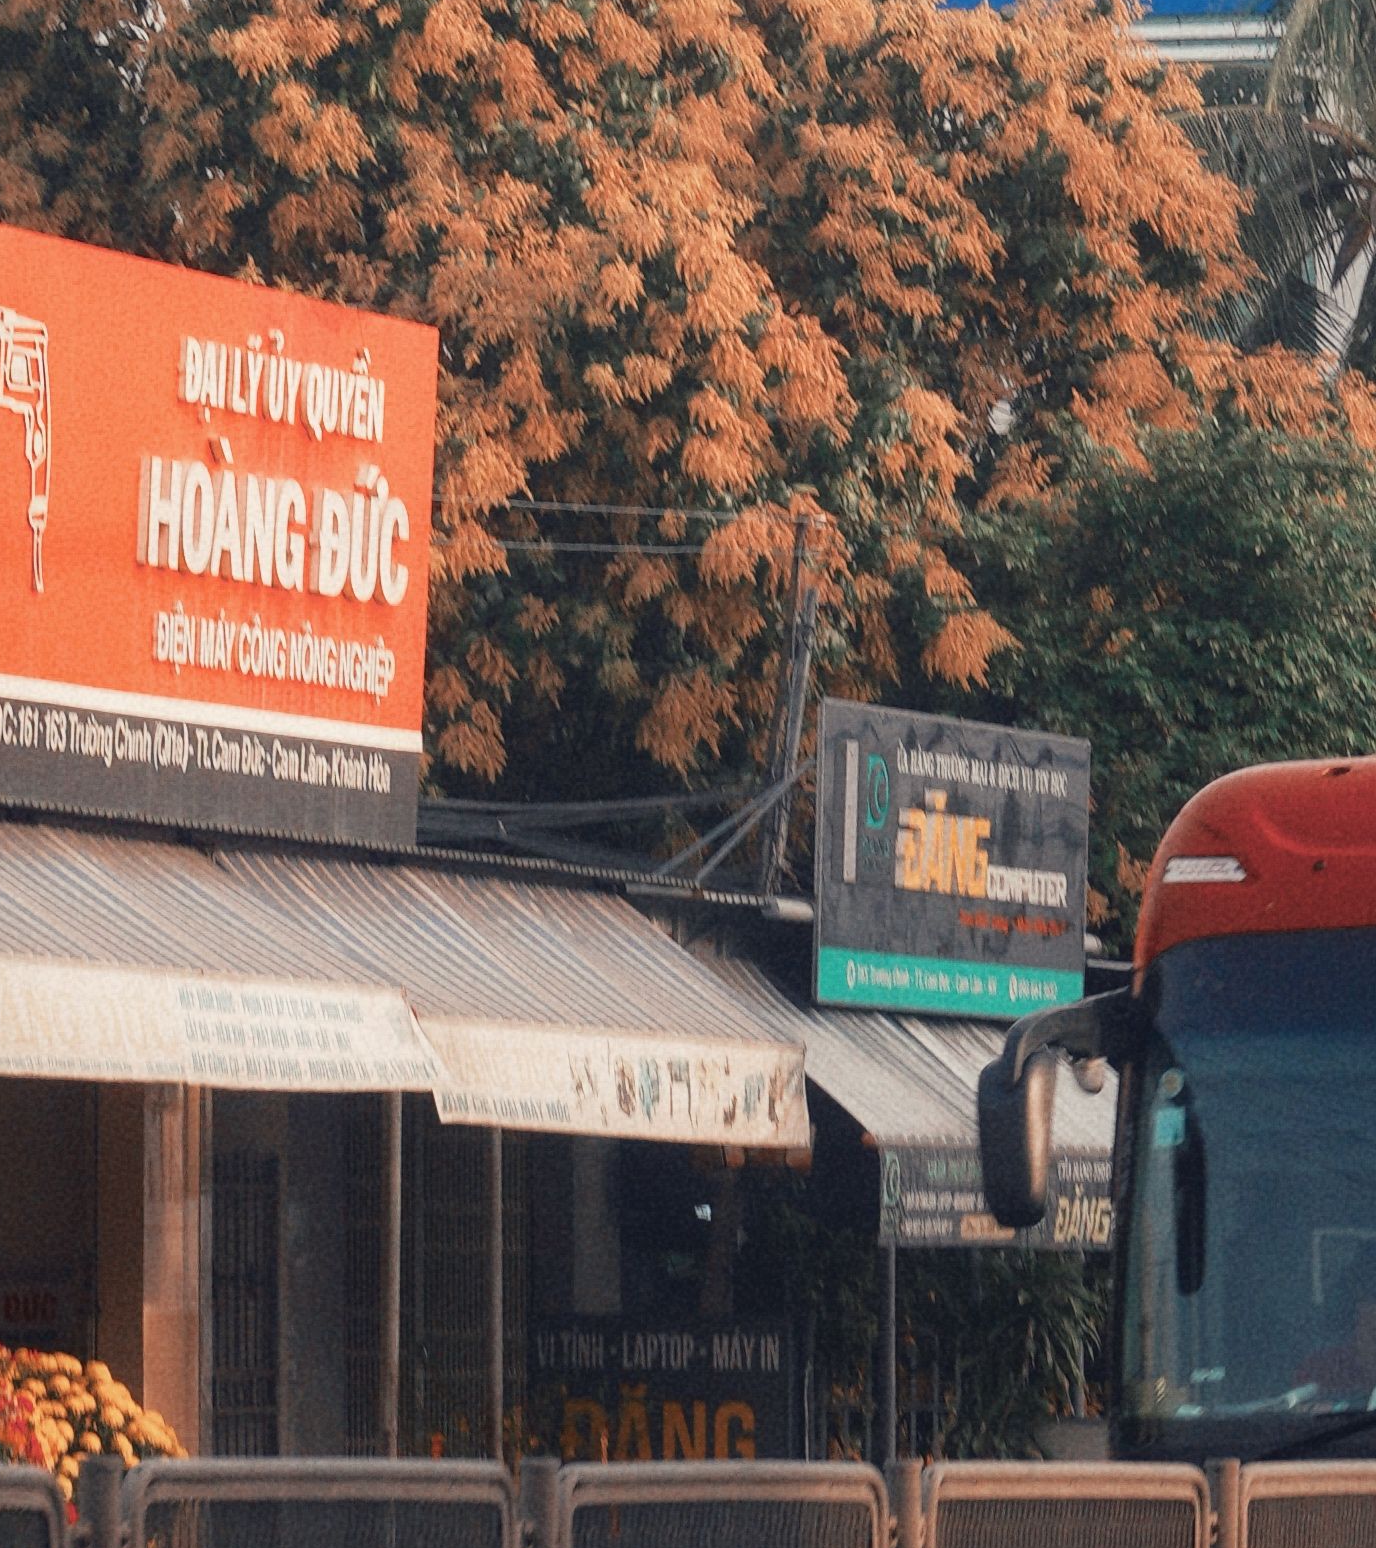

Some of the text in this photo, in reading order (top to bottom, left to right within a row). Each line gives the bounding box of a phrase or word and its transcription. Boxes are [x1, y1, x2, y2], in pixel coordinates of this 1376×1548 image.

[180, 334, 227, 423] ĐẠI
[304, 347, 386, 443] QUYỀN
[139, 435, 410, 605] HOÀNG ĐỨC
[155, 599, 396, 706] ĐIỆN MÁY CÔNG NÔNG NGHIỆP
[69, 713, 112, 768] Trường
[212, 729, 241, 774] Cam
[242, 734, 266, 777] Đức
[272, 738, 299, 782] Cam
[987, 864, 1068, 908] COMPUTER
[1055, 1183, 1112, 1244] ĐĂNG
[624, 1332, 695, 1371] LAPTOP
[712, 1325, 756, 1372] MÁY
[760, 1332, 780, 1372] IN
